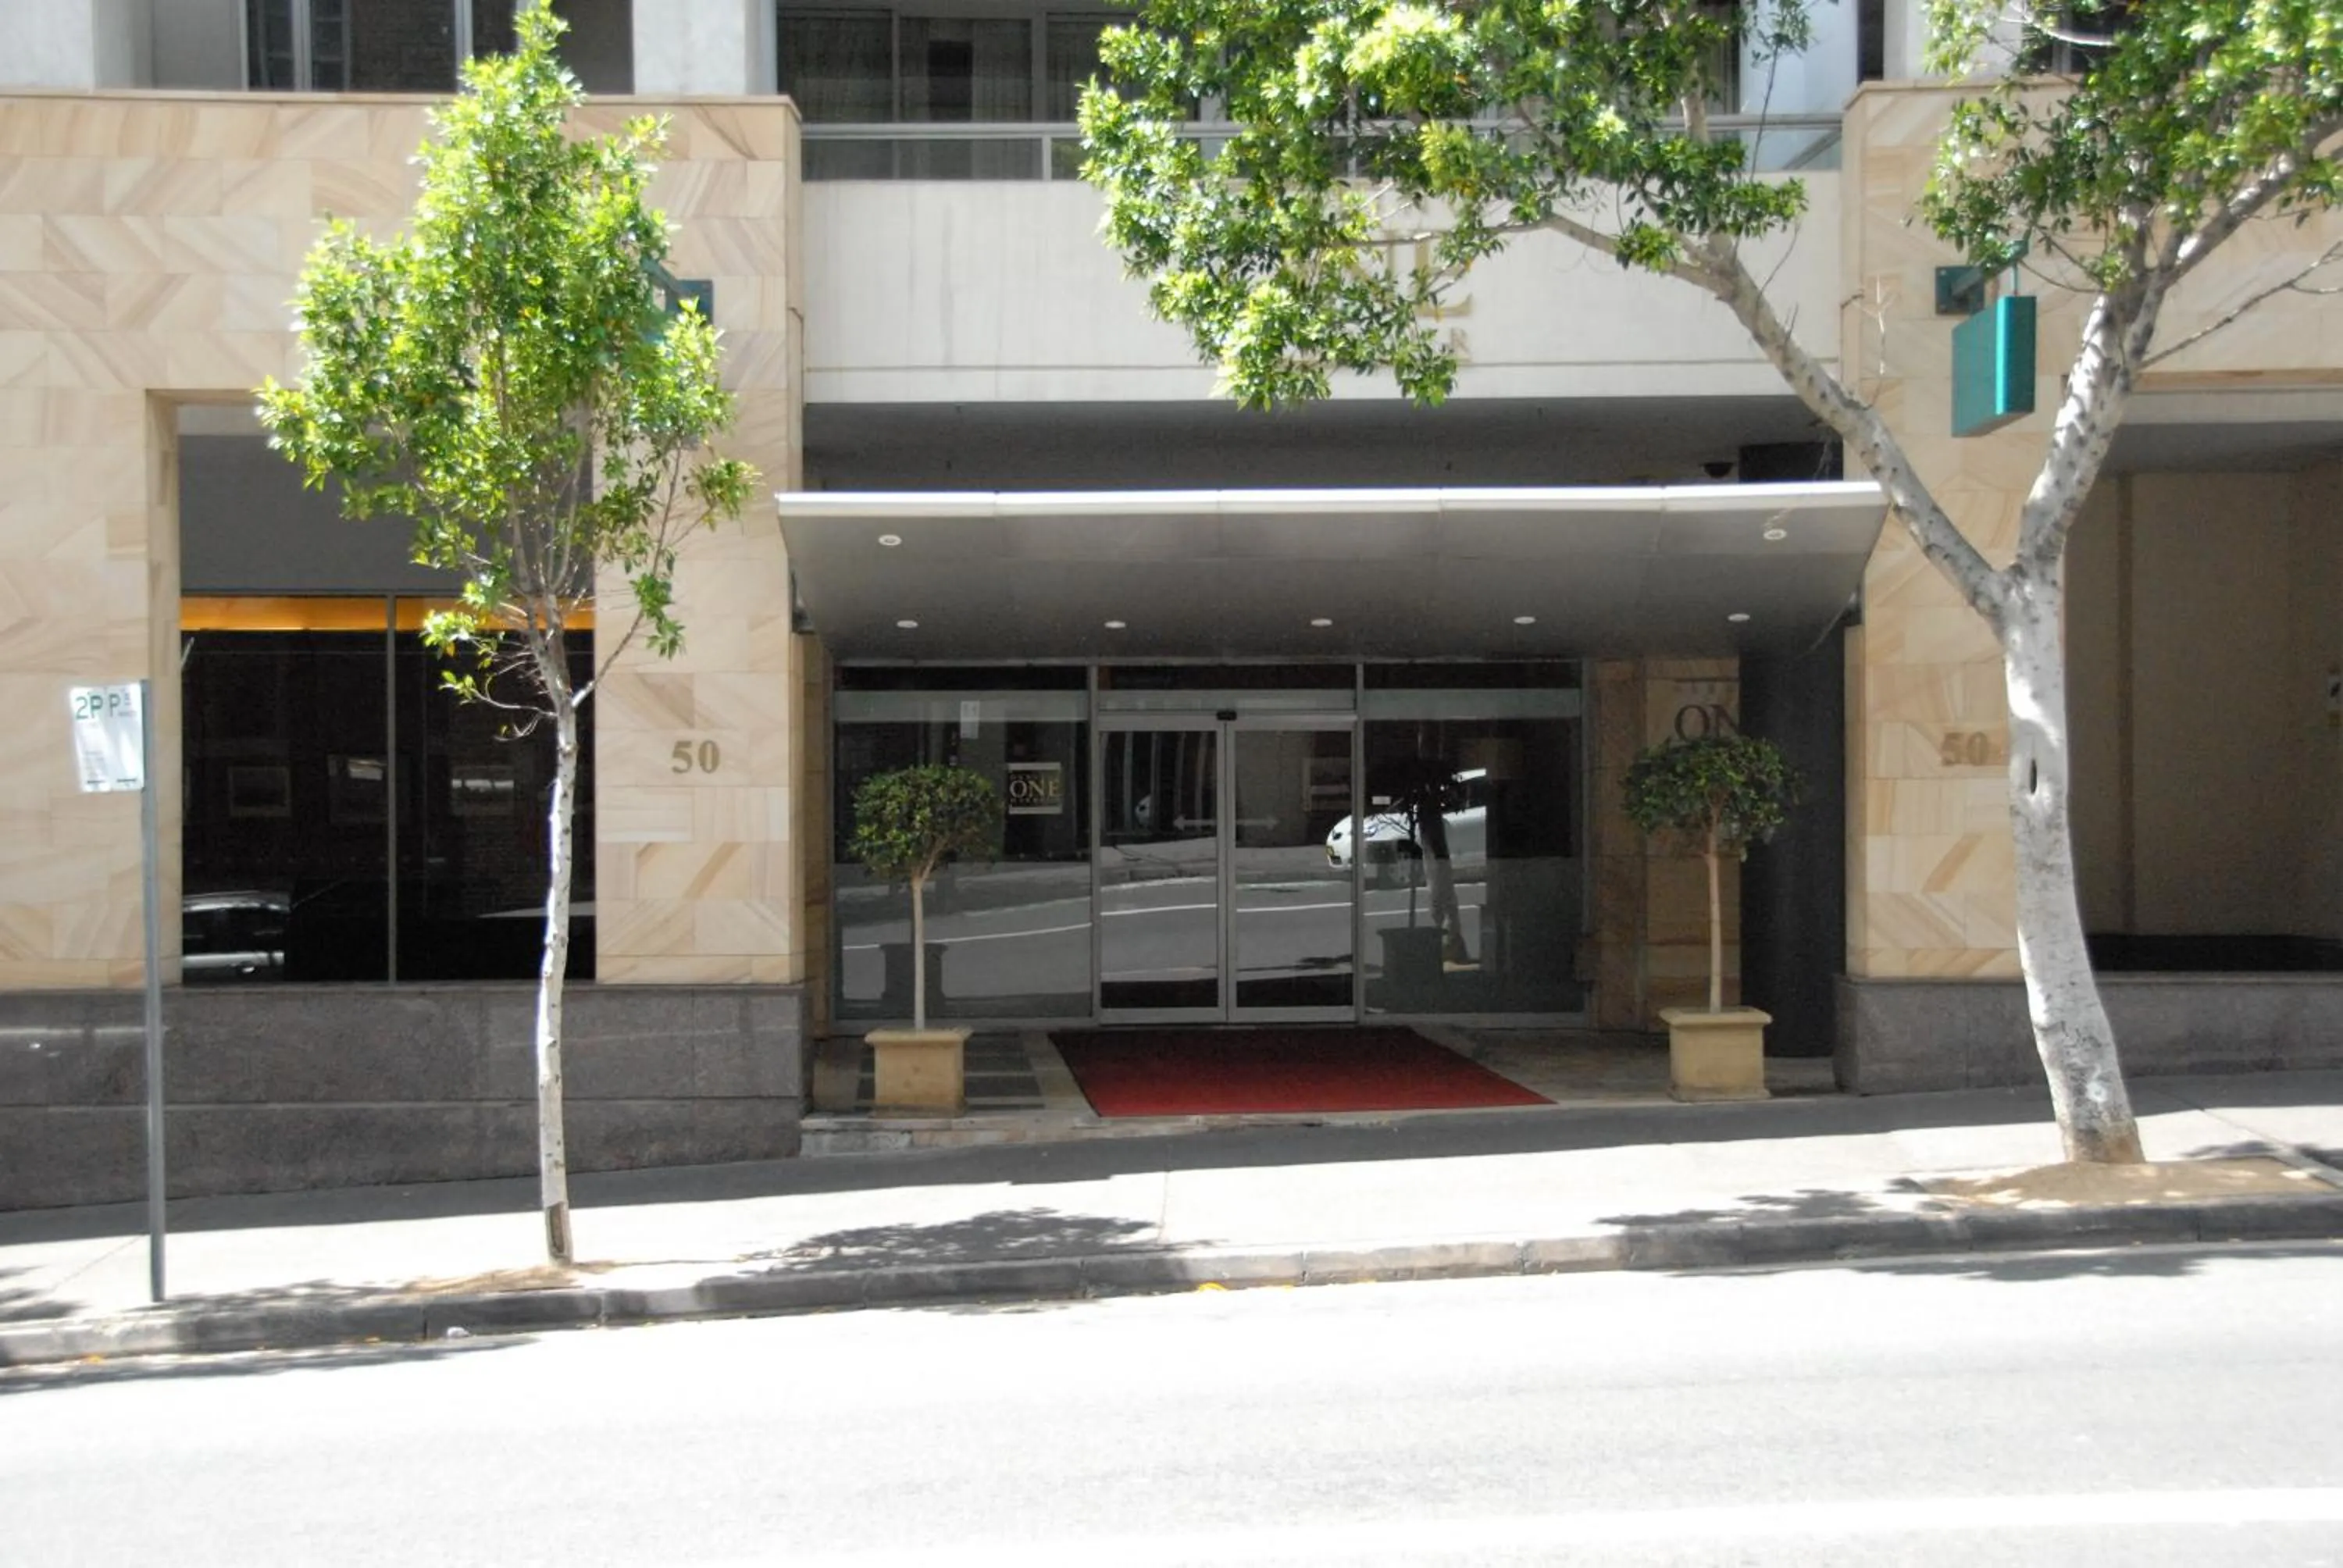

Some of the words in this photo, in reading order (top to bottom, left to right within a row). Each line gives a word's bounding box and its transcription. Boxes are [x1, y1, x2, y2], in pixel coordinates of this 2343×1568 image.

[76, 694, 103, 719] 2P
[671, 739, 720, 774] 50
[1941, 731, 1988, 766] 50
[1009, 779, 1061, 798] ONE
